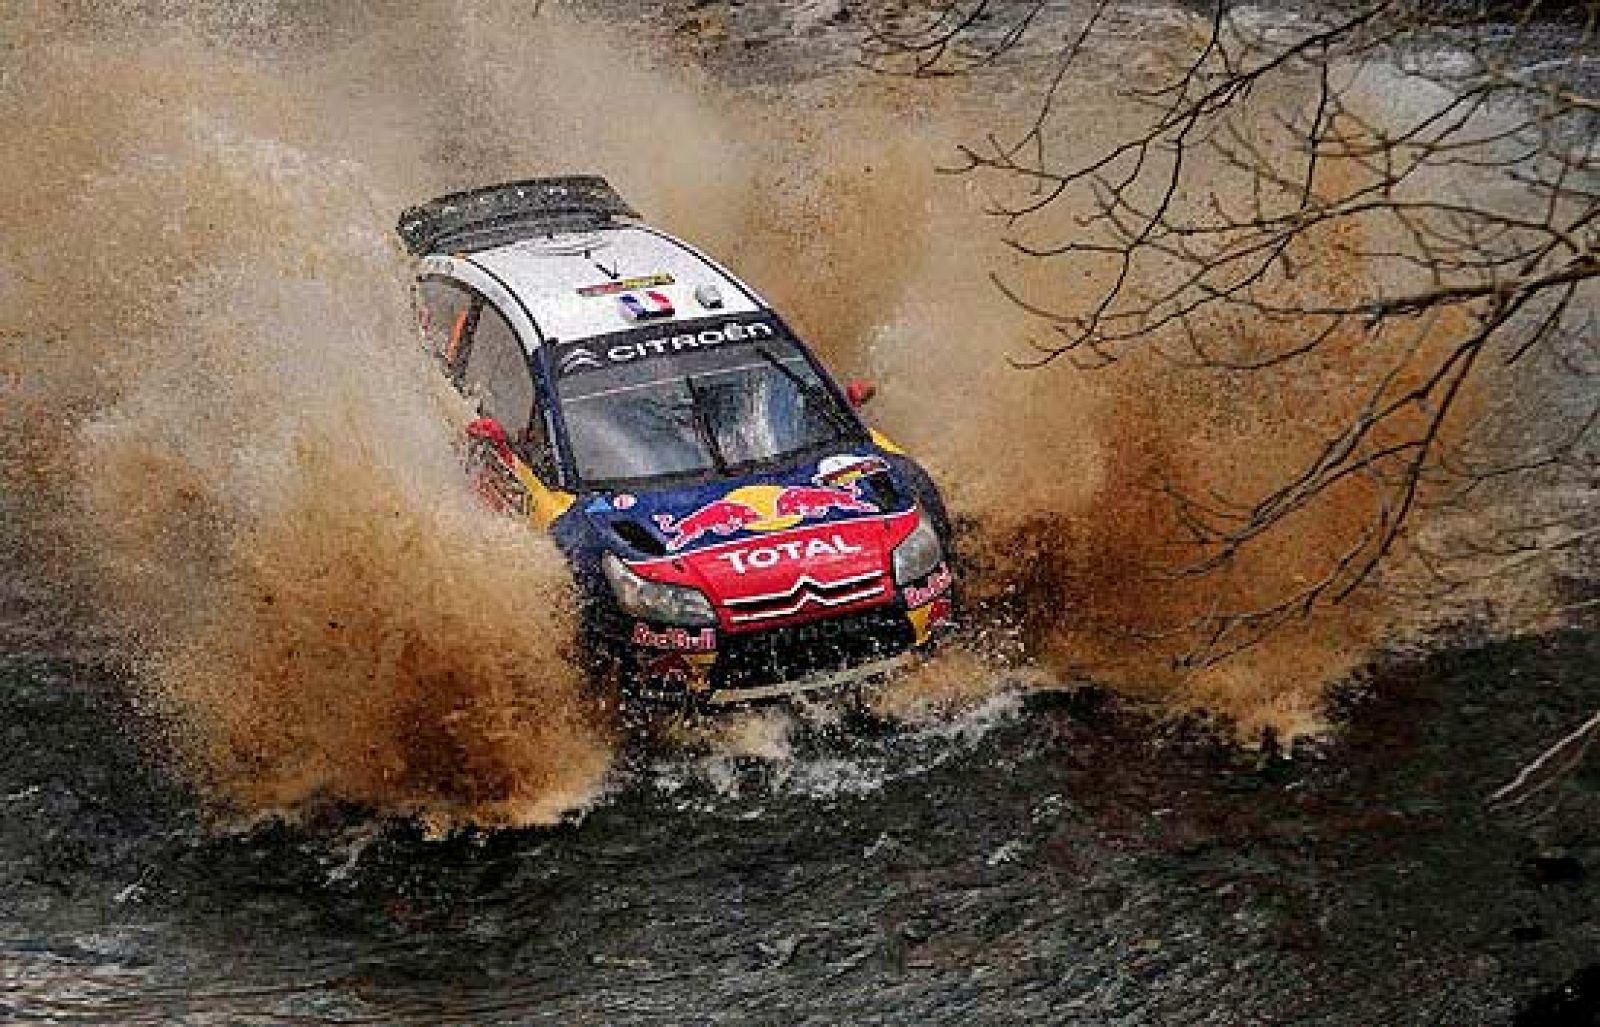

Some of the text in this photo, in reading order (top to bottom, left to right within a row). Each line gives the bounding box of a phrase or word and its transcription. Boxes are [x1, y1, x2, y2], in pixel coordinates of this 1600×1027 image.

[717, 535, 862, 574] TOTAL
[632, 621, 717, 650] Red Bull
